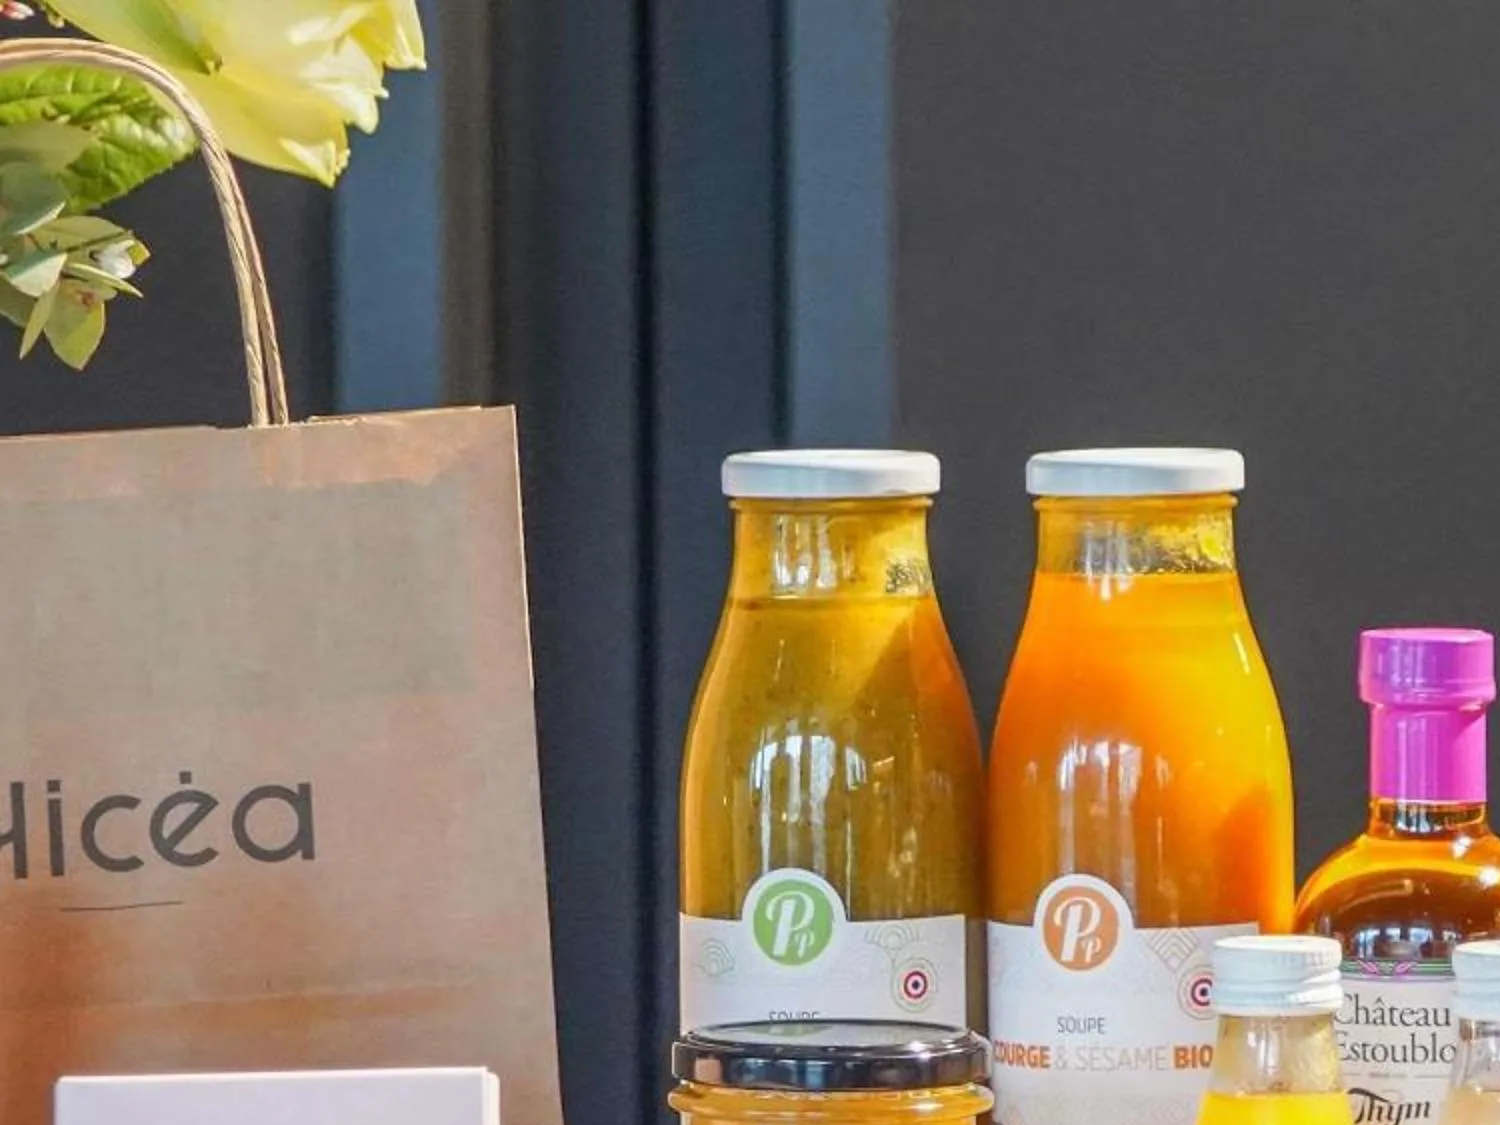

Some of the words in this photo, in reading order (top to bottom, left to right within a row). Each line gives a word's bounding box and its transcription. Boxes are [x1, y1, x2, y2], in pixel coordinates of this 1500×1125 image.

[1058, 1016, 1105, 1034] SOUPE
[1173, 1045, 1213, 1069] BIO
[1336, 1031, 1457, 1064] Estoublo
